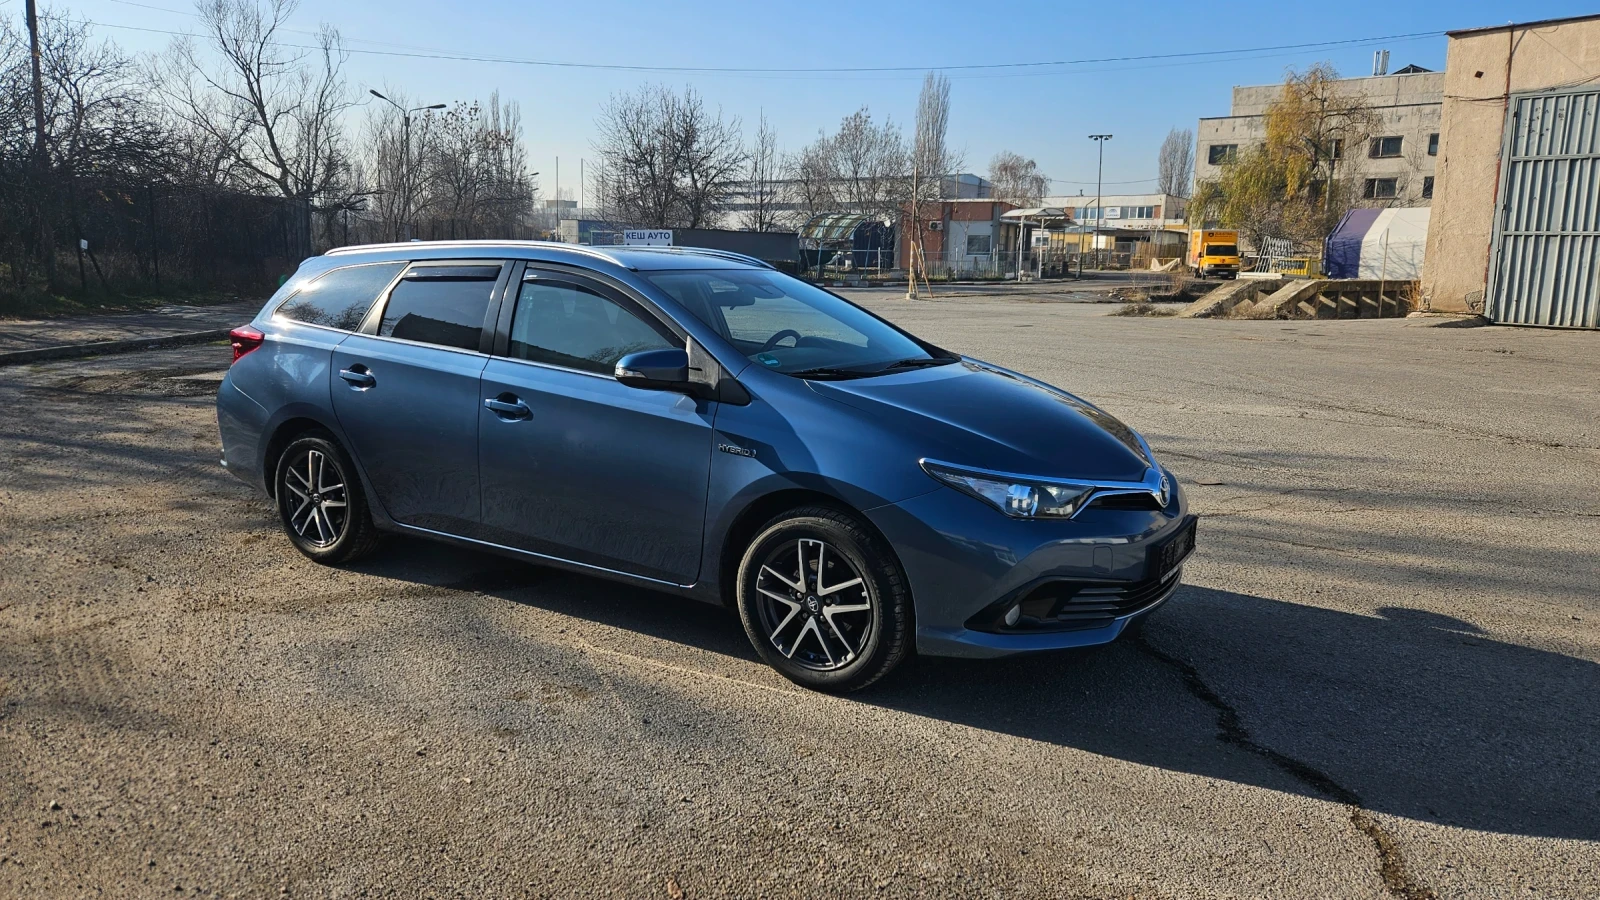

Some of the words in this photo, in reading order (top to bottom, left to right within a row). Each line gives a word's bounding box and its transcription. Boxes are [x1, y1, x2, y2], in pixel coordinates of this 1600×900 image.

[625, 231, 646, 240] КЕШ
[647, 231, 671, 240] АУТО
[718, 443, 751, 456] HYBRID
